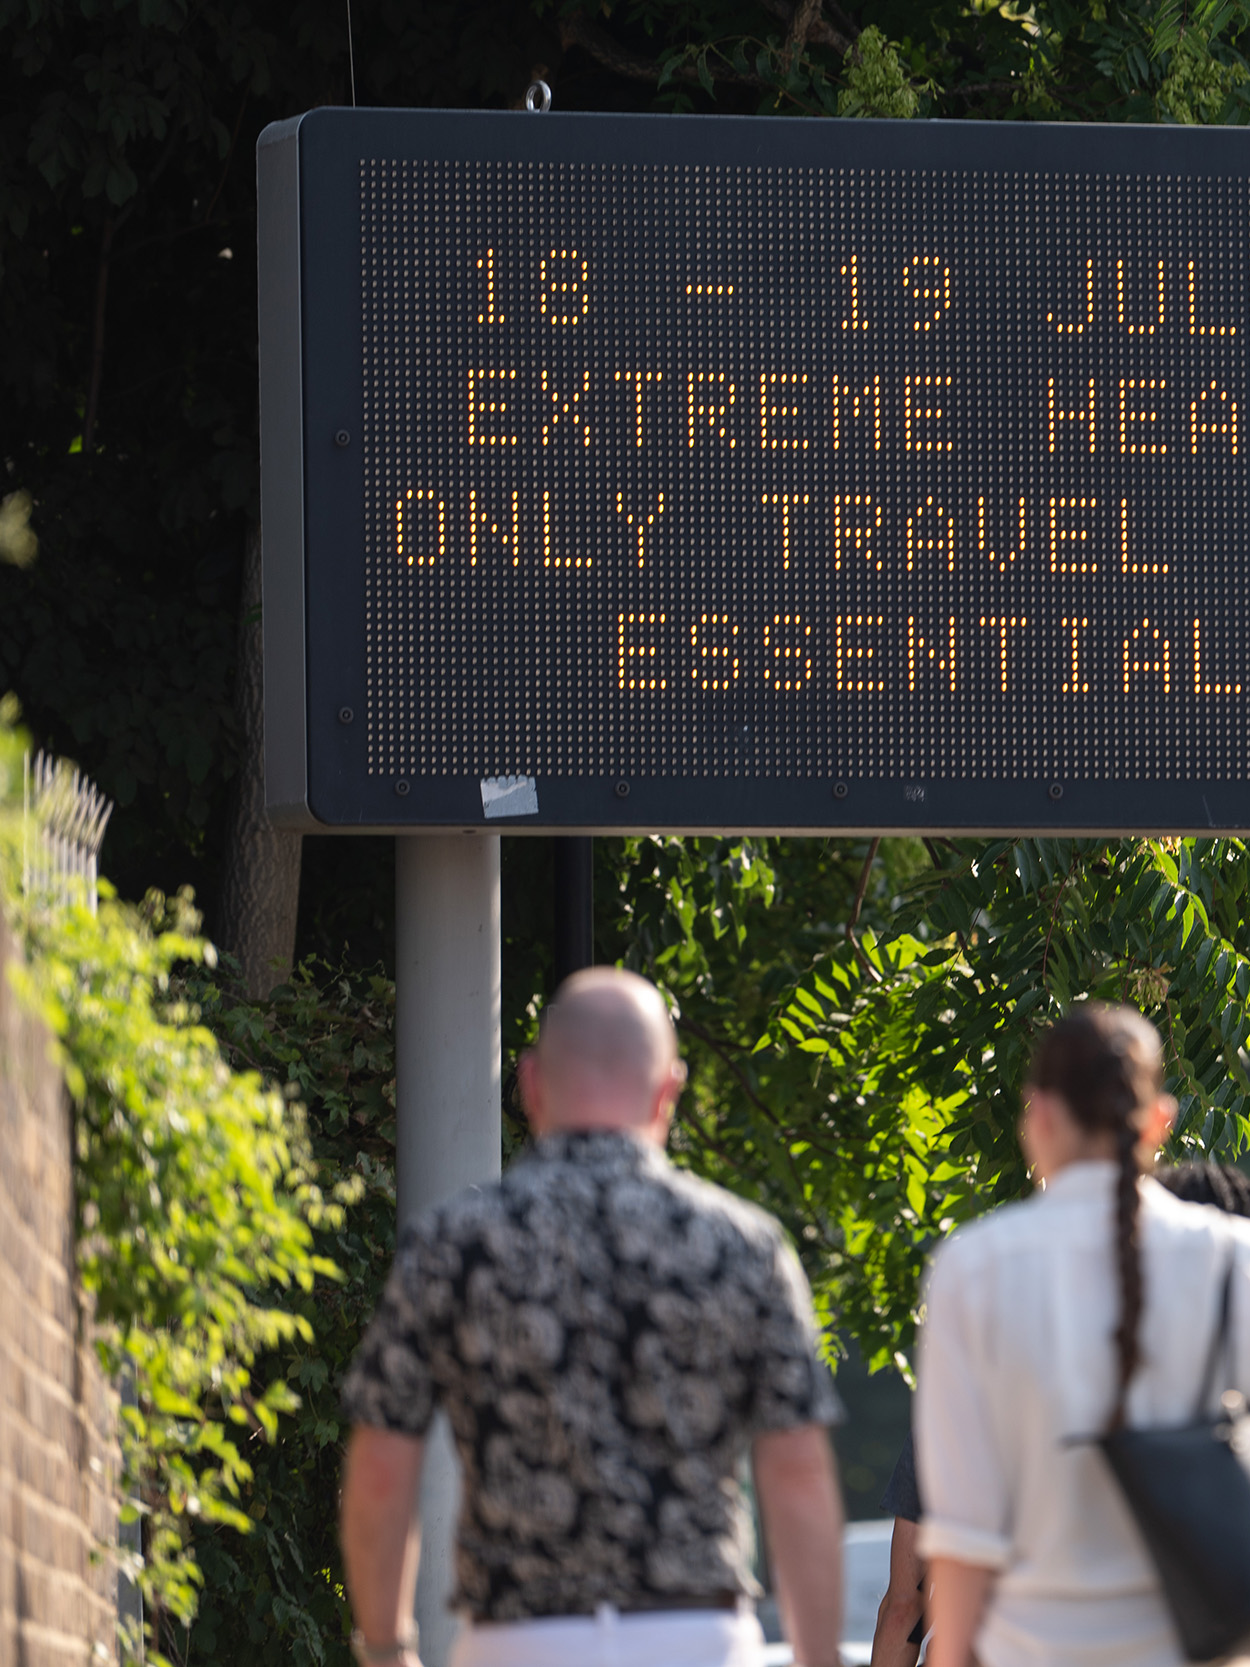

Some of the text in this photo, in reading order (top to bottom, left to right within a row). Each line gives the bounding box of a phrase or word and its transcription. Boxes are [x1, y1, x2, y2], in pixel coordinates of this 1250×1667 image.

[476, 248, 589, 326] 18
[685, 284, 734, 296] -
[840, 254, 951, 332] 19
[467, 369, 953, 452] EXTREME
[395, 489, 665, 569] ONLY
[761, 493, 1169, 574] TRAVEL
[617, 613, 1242, 695] ESSENTIAL
